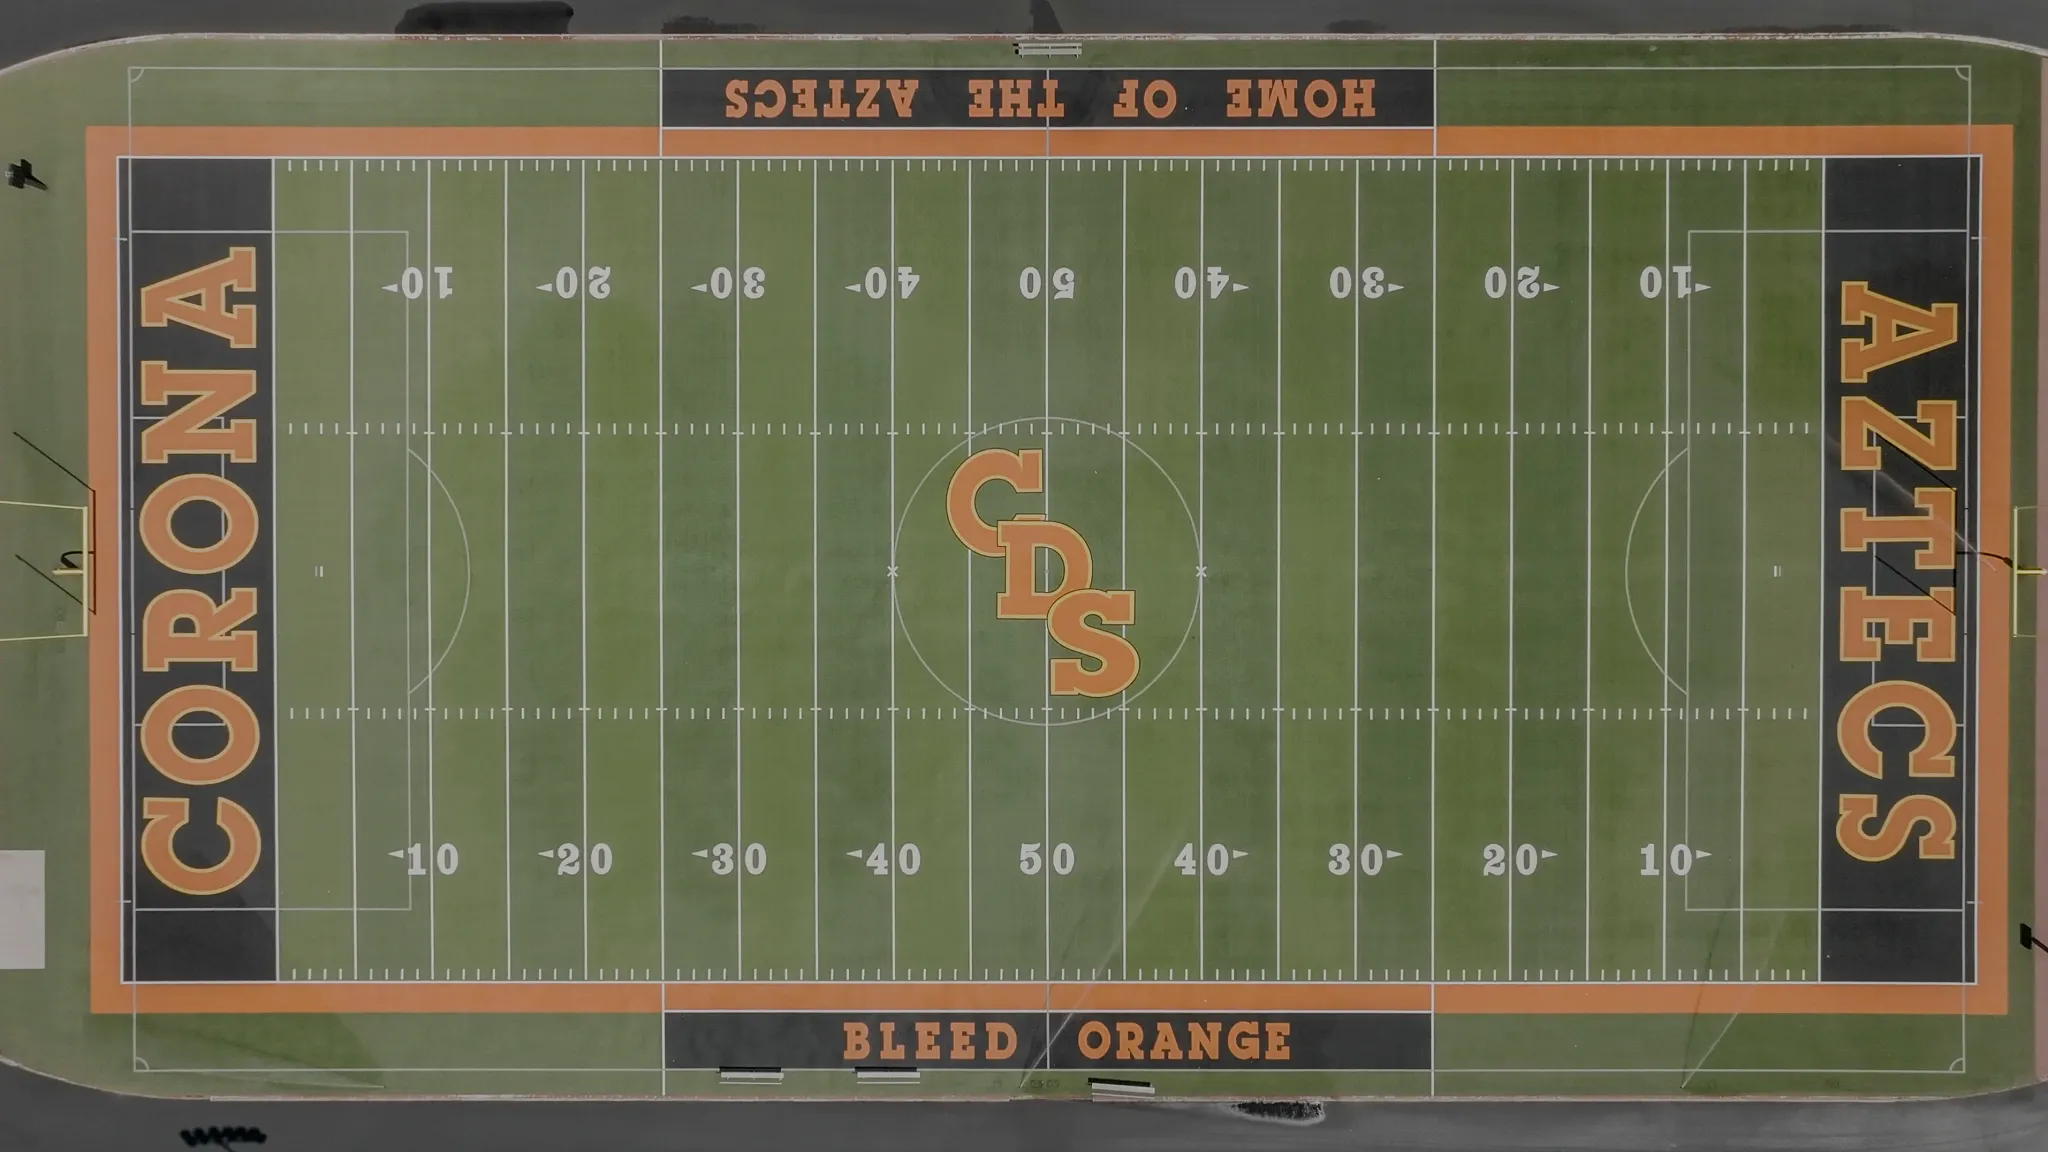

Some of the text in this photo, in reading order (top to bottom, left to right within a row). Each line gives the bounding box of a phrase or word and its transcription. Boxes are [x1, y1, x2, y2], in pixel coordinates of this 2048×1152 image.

[725, 78, 1376, 118] HOME OF THE AZTECS
[402, 266, 453, 299] 10
[555, 266, 611, 299] 20
[710, 266, 766, 299] 30
[864, 266, 921, 299] 40
[1019, 266, 1076, 299] 50
[1174, 266, 1230, 299] 40
[1329, 266, 1385, 299] 30
[1485, 266, 1540, 299] 20
[1641, 266, 1692, 299] 10
[139, 246, 262, 896] CORONA
[946, 449, 1140, 698] CDS
[1837, 281, 1958, 862] AZTECS
[407, 842, 459, 876] 10
[557, 842, 613, 876] 20
[711, 843, 768, 876] 30
[866, 843, 921, 876] 40
[1019, 843, 1075, 876] 50
[1174, 843, 1229, 876] 40
[1328, 843, 1384, 876] 30
[1482, 842, 1538, 876] 20
[1640, 842, 1692, 876] 10
[842, 1021, 1291, 1060] BLEED ORANGE
